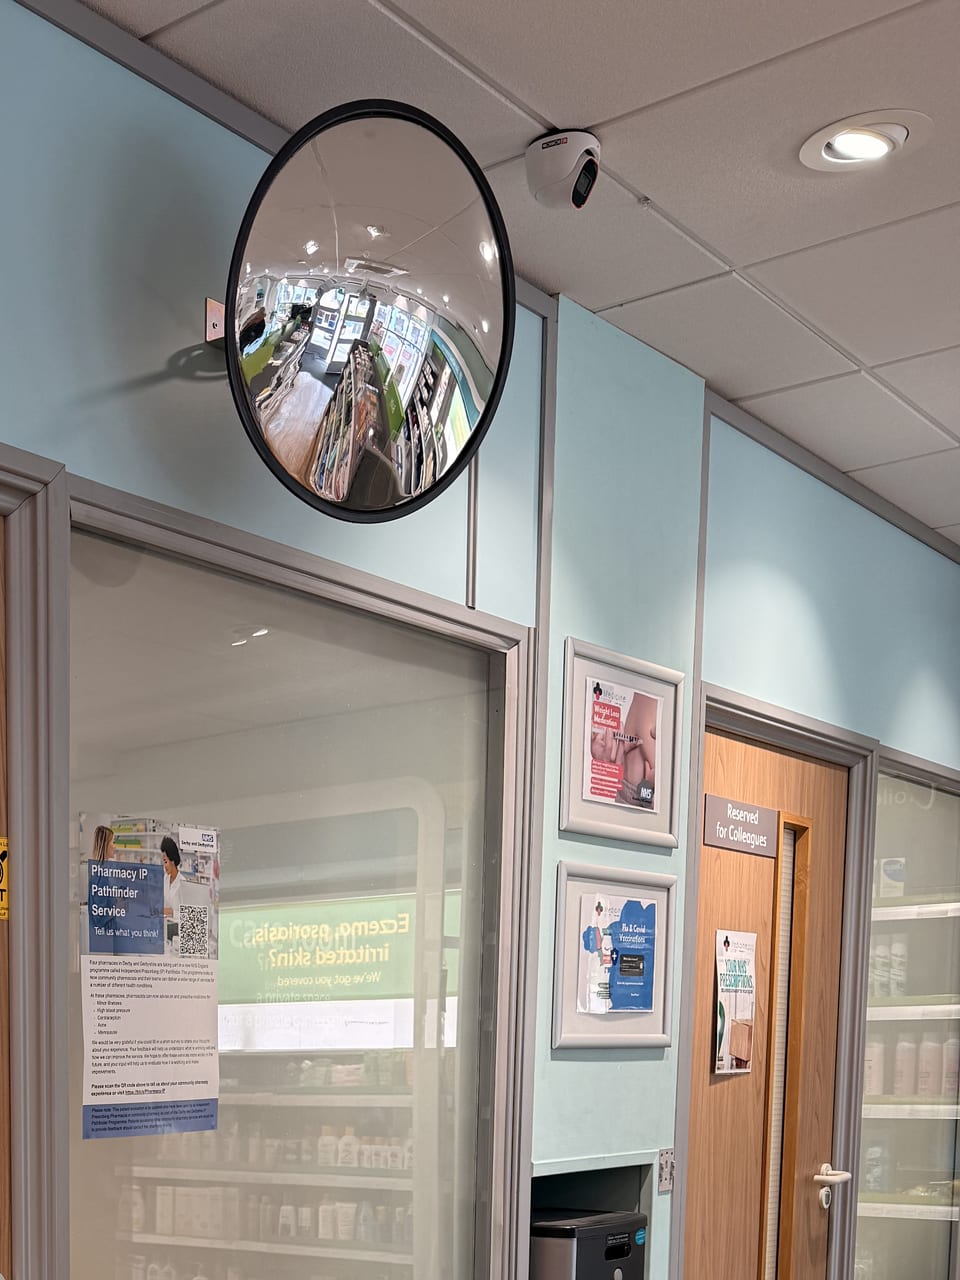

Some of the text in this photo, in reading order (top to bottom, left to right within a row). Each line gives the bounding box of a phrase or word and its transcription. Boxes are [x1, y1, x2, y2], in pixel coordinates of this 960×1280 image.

[594, 703, 619, 719] Weight Loss
[640, 787, 652, 799] NHS
[728, 803, 759, 824] Reserved
[716, 821, 767, 848] for Colleagues
[91, 865, 148, 881] Pharmacy IP
[91, 884, 138, 898] Pathfinder
[91, 904, 125, 917] Service
[94, 926, 104, 936] Tell
[115, 929, 129, 937] what
[143, 929, 159, 937] think!
